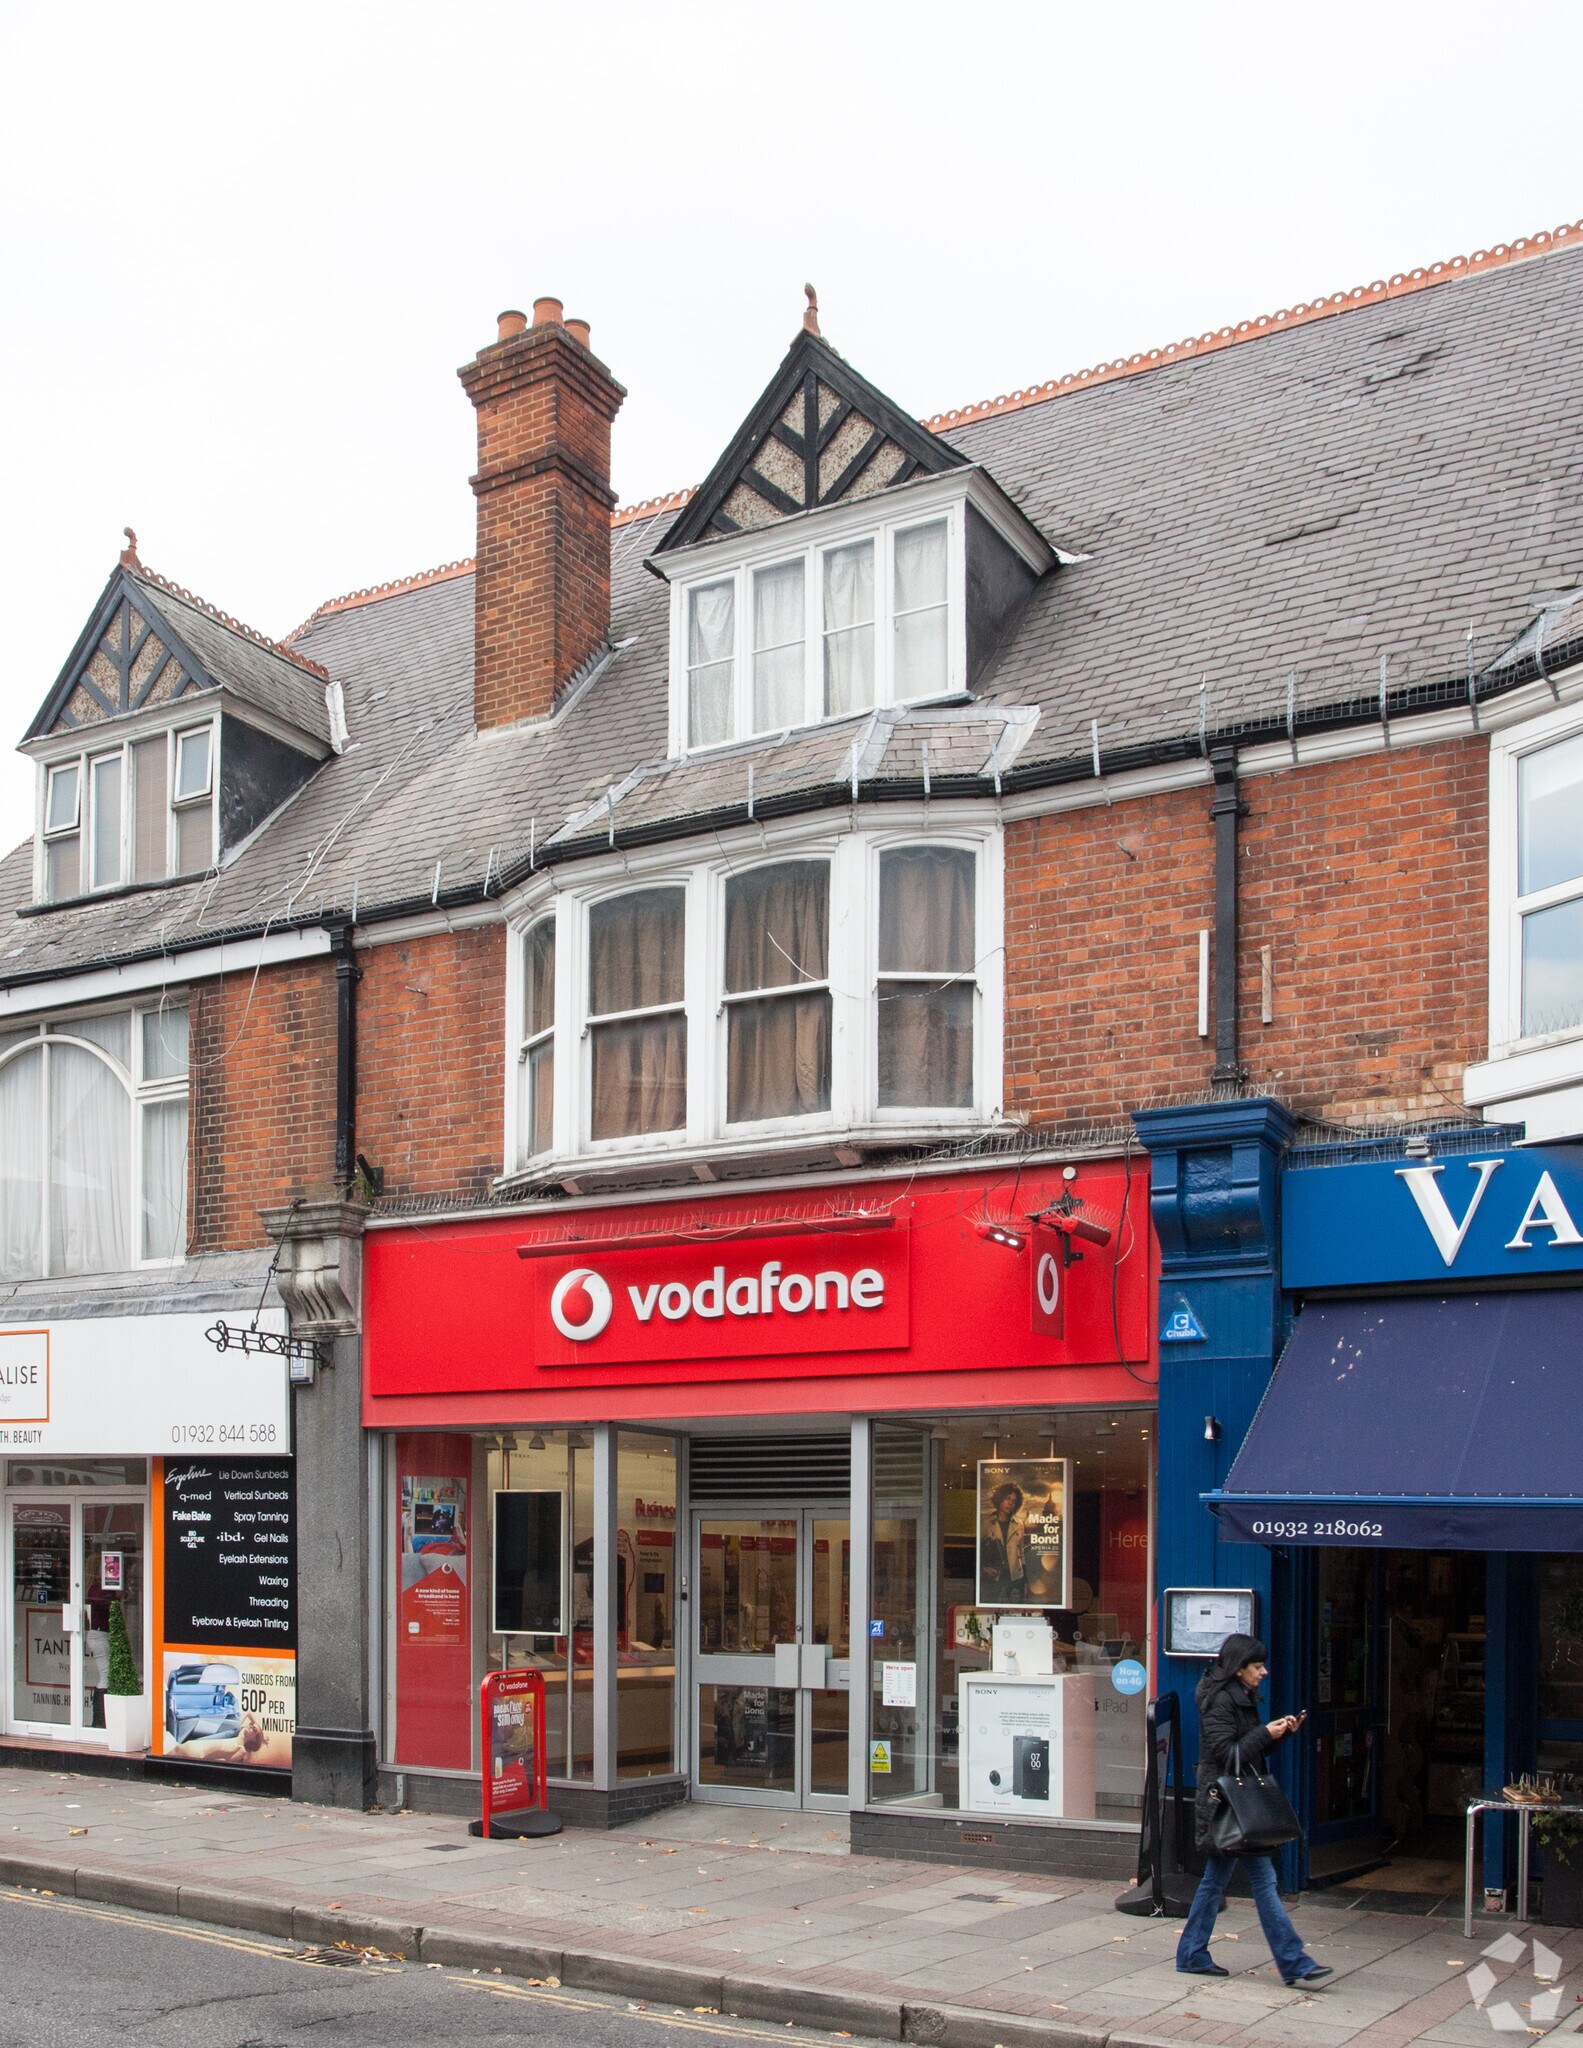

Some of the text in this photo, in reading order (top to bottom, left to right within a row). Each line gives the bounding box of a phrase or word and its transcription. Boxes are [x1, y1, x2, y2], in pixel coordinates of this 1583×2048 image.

[1394, 1159, 1583, 1267] VA
[627, 1260, 886, 1321] vodafone
[1166, 1329, 1197, 1338] Chubb
[13, 1430, 43, 1444] BEAUTY
[171, 1424, 277, 1443] 01932 844 588
[165, 1465, 213, 1490] Ergoline
[219, 1469, 289, 1480] Lie Down Sunbeds
[224, 1490, 289, 1500] Vertical Sunbeds
[234, 1511, 289, 1524] Spray Tanning
[1028, 1513, 1060, 1524] Made
[1043, 1523, 1060, 1534] for
[1252, 1519, 1383, 1537] 01932 218062
[253, 1532, 289, 1543] Gel Nails
[1030, 1534, 1059, 1544] Bond
[1110, 1530, 1148, 1548] Here
[219, 1553, 289, 1565] Eyelash Extensions
[259, 1576, 289, 1587] Waxing
[249, 1597, 289, 1609] Threading
[191, 1616, 289, 1631] Eyebrow & Eyelash Tinting
[1119, 1666, 1141, 1676] Now
[241, 1673, 296, 1687] SUNBEDS FROM
[505, 1681, 528, 1690] vodafone
[1129, 1677, 1143, 1686] 4G
[241, 1689, 285, 1715] 50P PER
[1102, 1699, 1128, 1713] iPad
[261, 1717, 295, 1734] MINUTE
